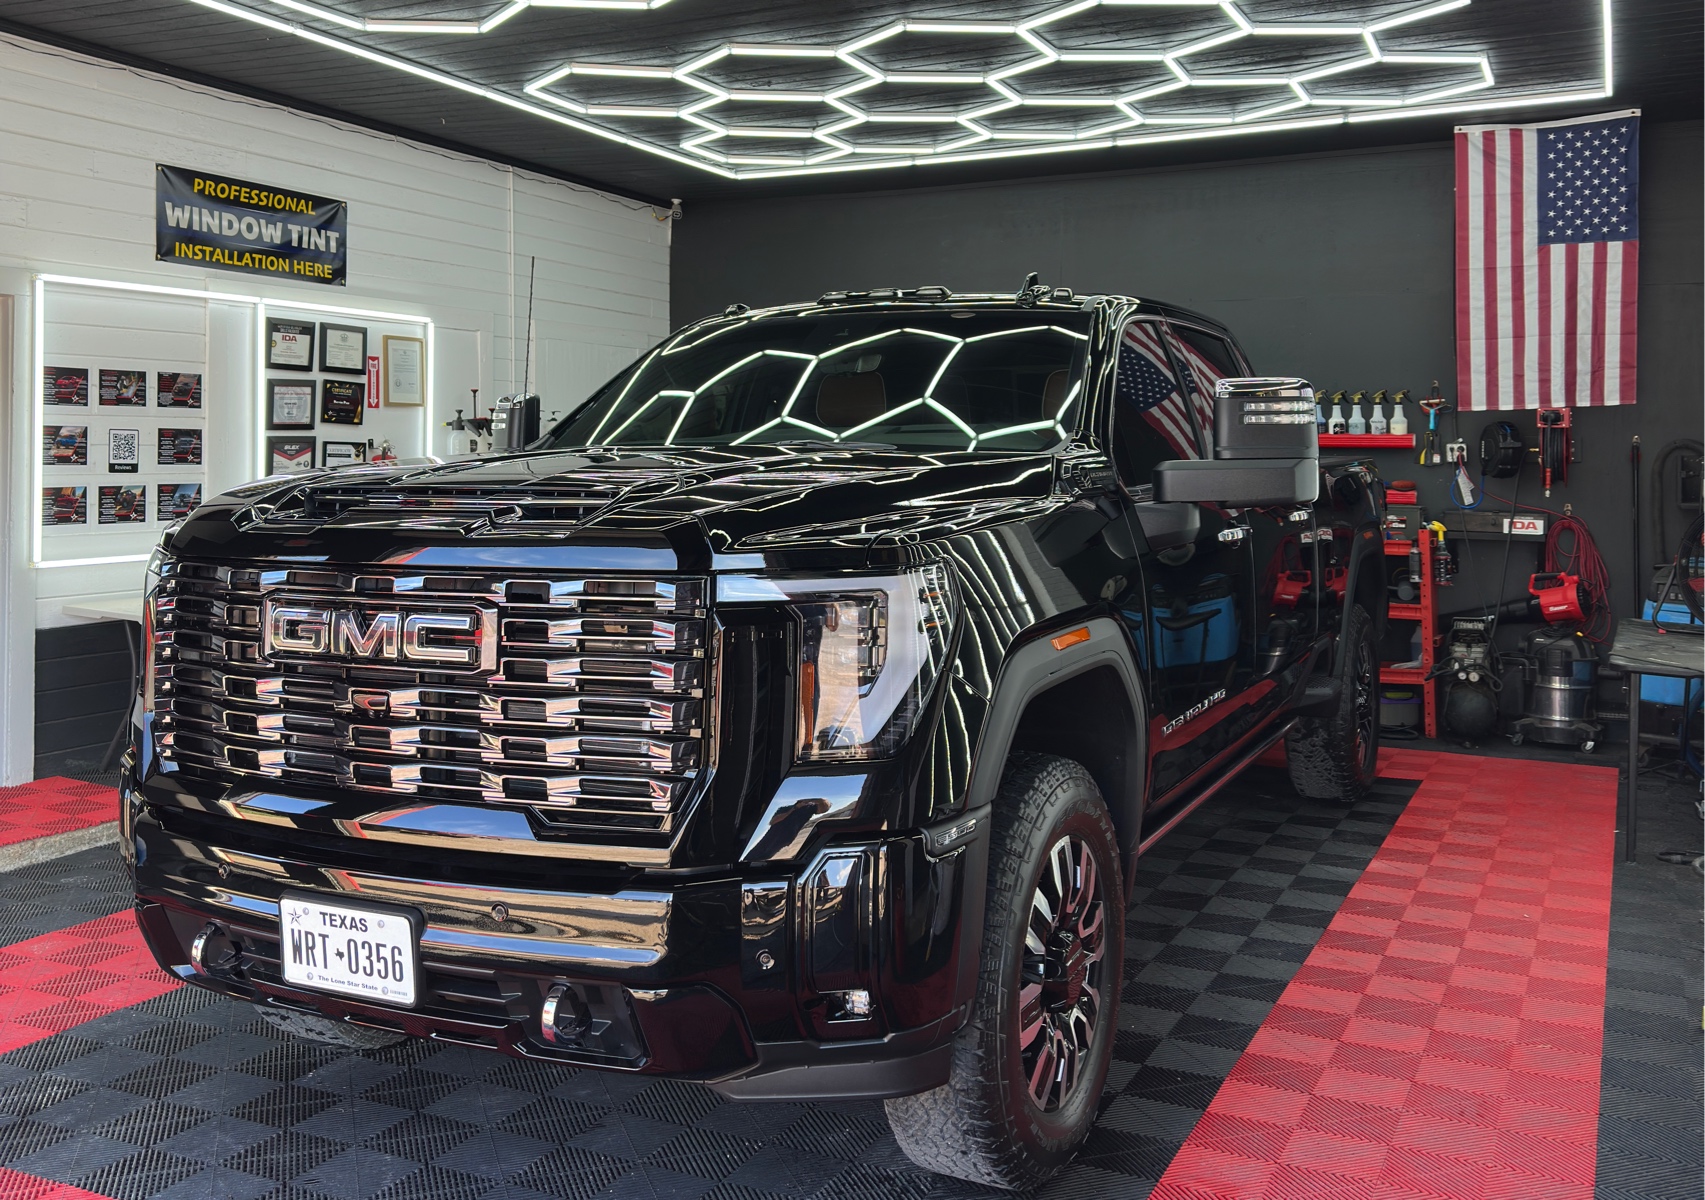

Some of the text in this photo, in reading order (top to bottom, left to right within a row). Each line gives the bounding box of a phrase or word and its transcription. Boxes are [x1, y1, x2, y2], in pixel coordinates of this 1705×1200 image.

[193, 177, 316, 216] PROFESSIONAL
[164, 201, 340, 254] WINDOW TINT
[174, 241, 333, 279] INSTALLATION HERE
[282, 334, 297, 342] IDA
[271, 606, 478, 663] GMC
[319, 911, 369, 933] TEXAS
[290, 928, 404, 983] WRT 0356
[317, 974, 379, 991] The Lone Star State
